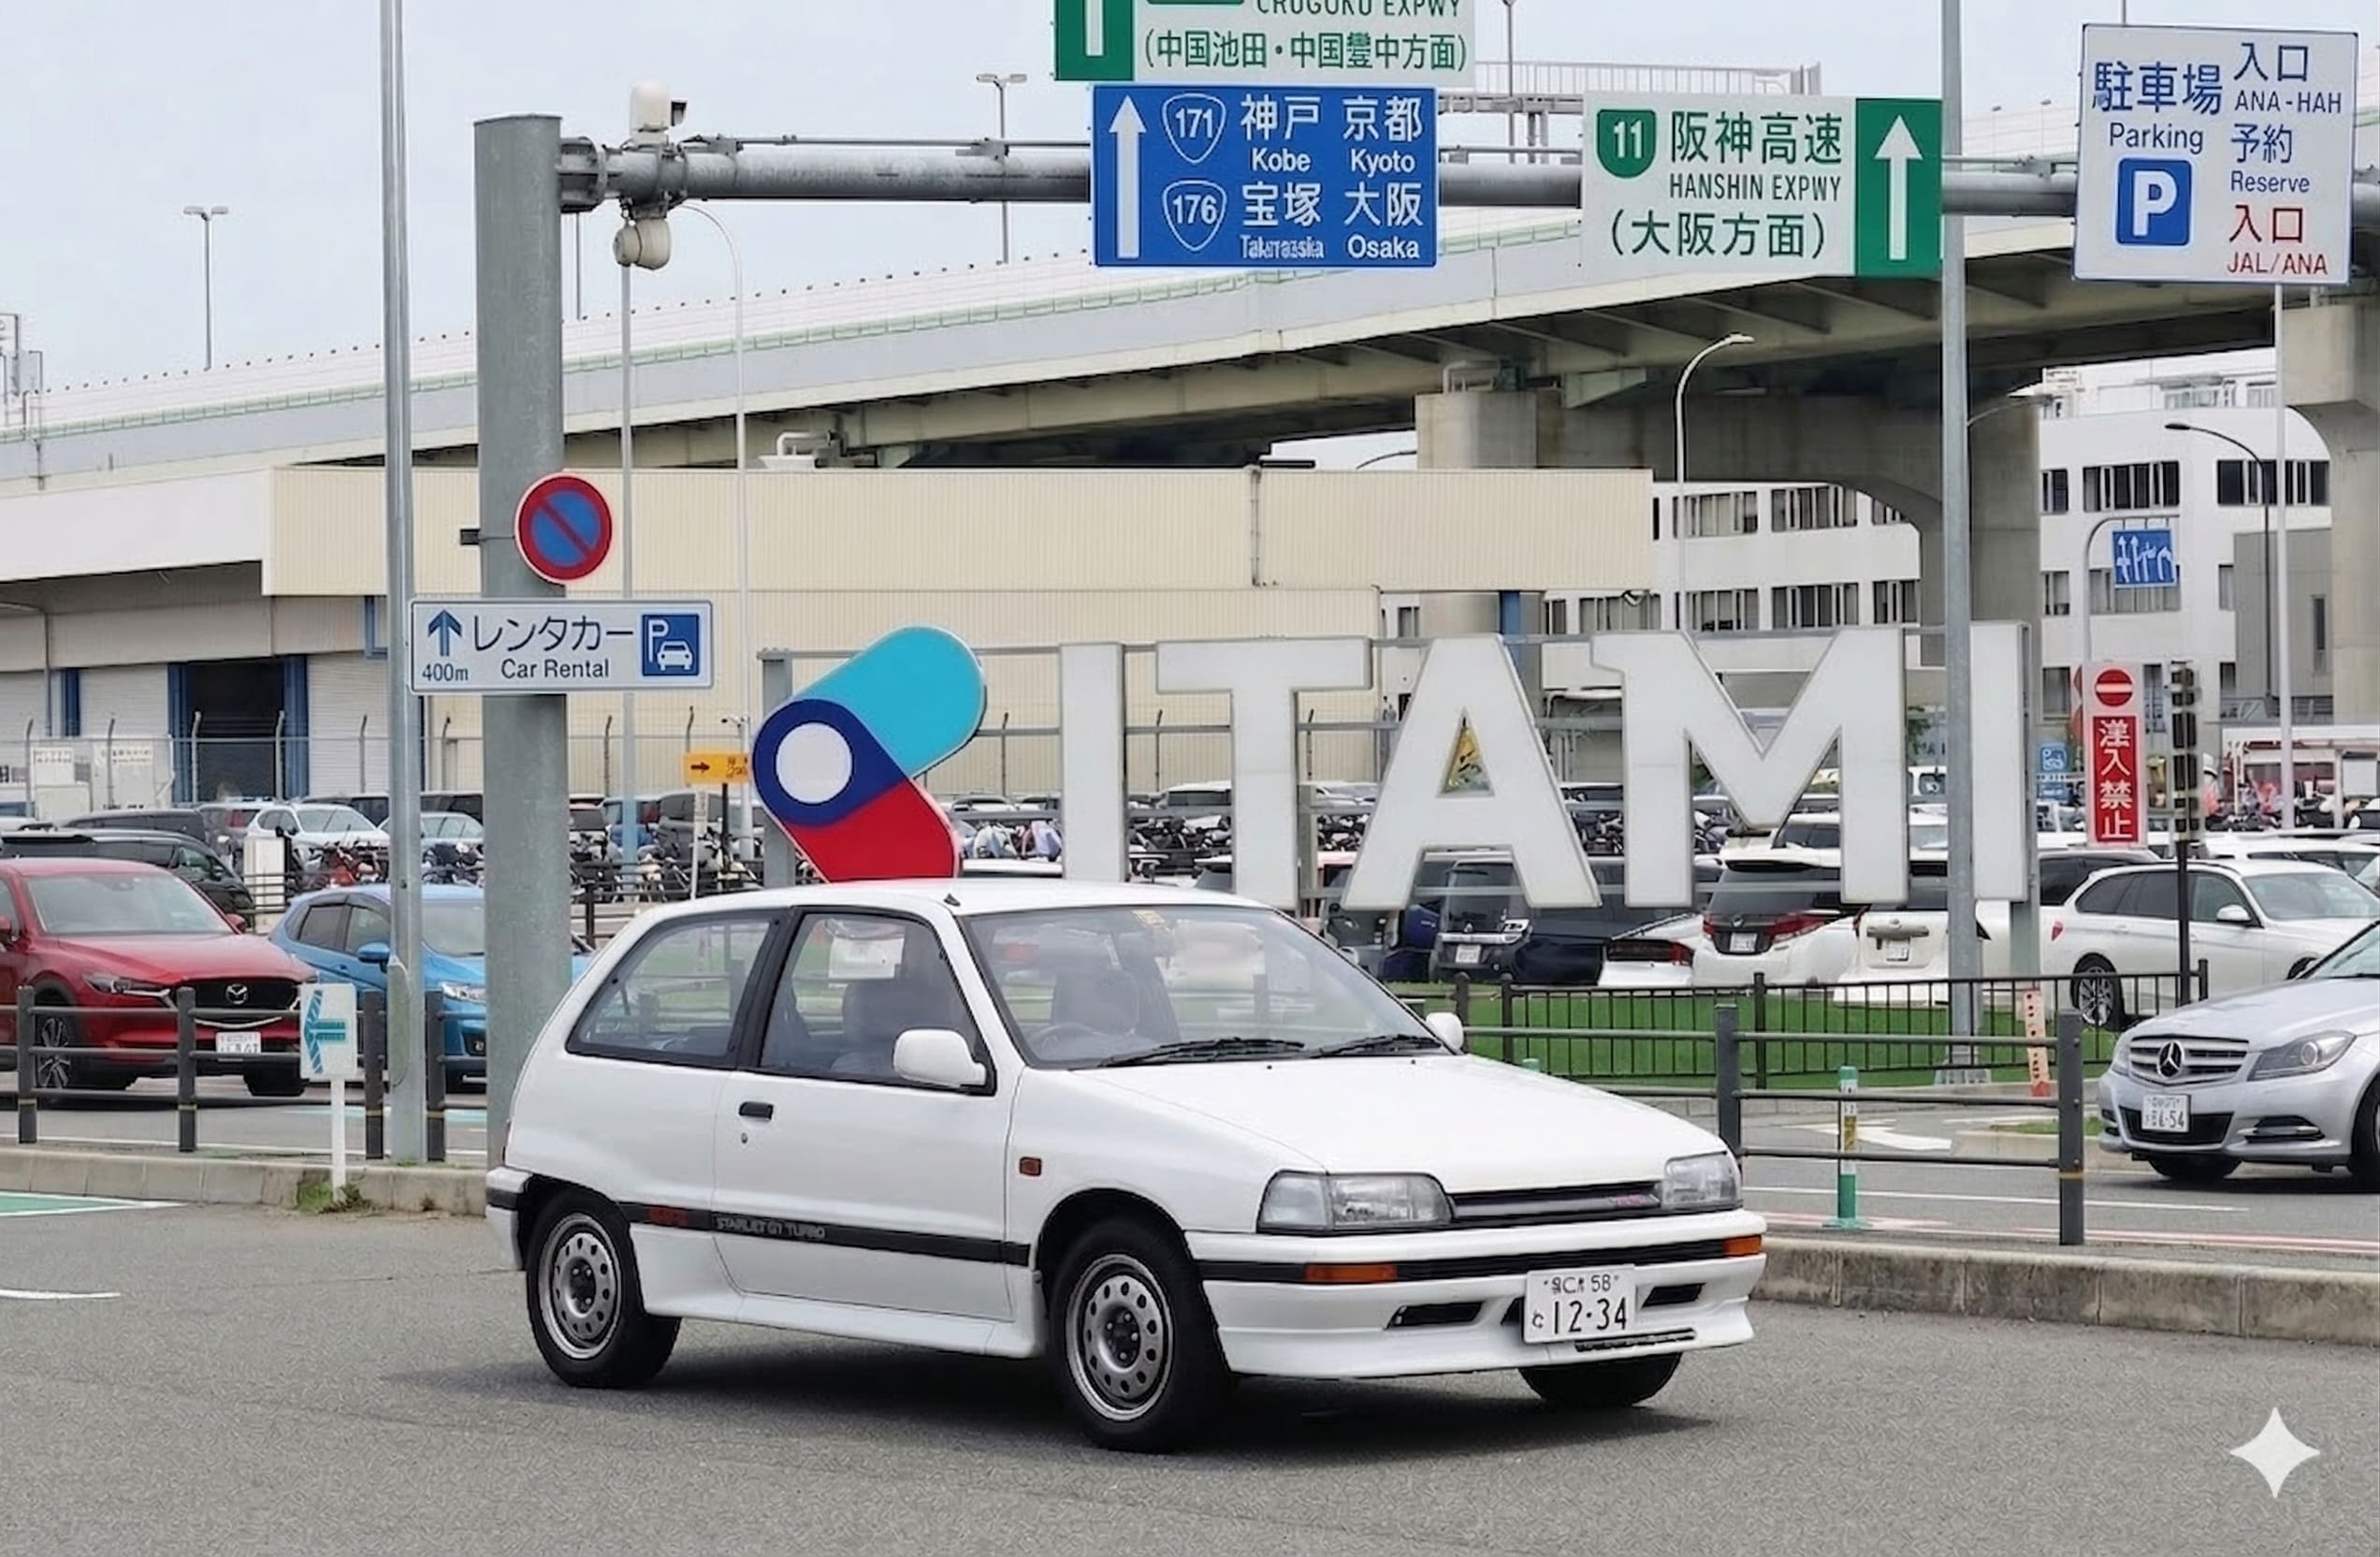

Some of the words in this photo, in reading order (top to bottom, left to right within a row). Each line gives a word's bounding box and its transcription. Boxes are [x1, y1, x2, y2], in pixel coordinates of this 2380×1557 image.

[1384, 0, 1459, 17] EXPWY
[2234, 42, 2309, 82] 入口
[2092, 61, 2223, 115] 駐車場
[1175, 108, 1213, 138] 171
[1241, 95, 1321, 141] 神戸
[1342, 95, 1423, 142] 京都
[1613, 120, 1644, 159] 11
[1671, 110, 1843, 165] 阪神高速
[2109, 122, 2204, 154] Parking
[2231, 123, 2293, 164] 予約
[1252, 147, 1312, 172] Kobe
[1350, 148, 1415, 178] Kyoto
[1670, 173, 1763, 200] HANSHIN
[1773, 174, 1842, 202] EXPWY
[2230, 169, 2311, 193] Reserve
[1172, 194, 1218, 226] 176
[1241, 182, 1322, 229] 宝塚
[1343, 182, 1424, 228] 大阪
[2132, 169, 2178, 238] P
[1611, 209, 1825, 259] （大阪方面）
[2228, 204, 2304, 244] 入口
[1347, 233, 1420, 259] Osaka
[2227, 252, 2329, 276] JAL/ANA
[473, 614, 634, 652] レンタカー
[422, 662, 469, 682] 400m
[501, 659, 538, 679] Car
[544, 658, 610, 679] Rental
[1058, 621, 2028, 910] ITAMI
[1590, 1273, 1611, 1293] 58
